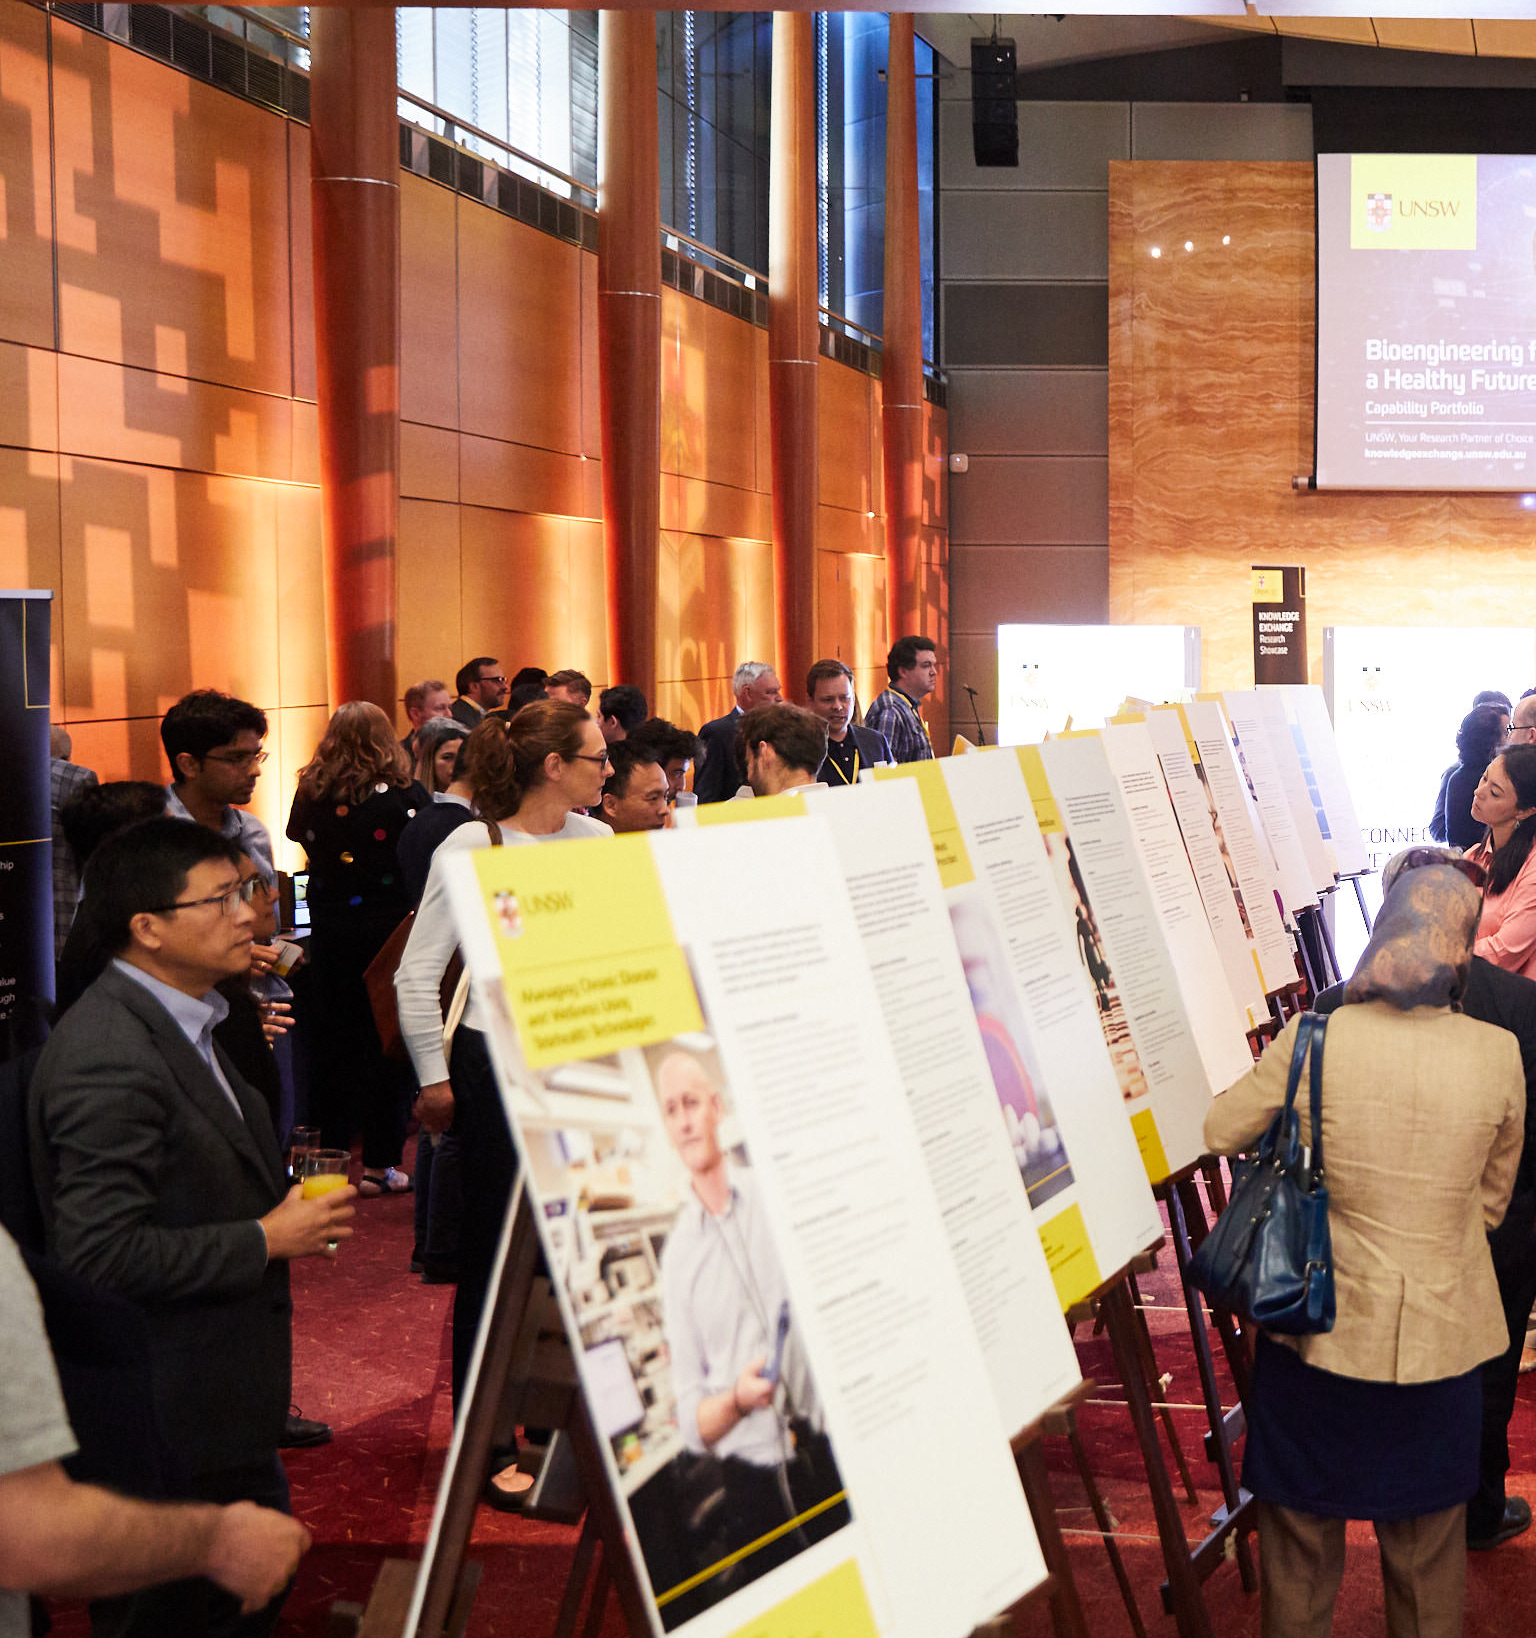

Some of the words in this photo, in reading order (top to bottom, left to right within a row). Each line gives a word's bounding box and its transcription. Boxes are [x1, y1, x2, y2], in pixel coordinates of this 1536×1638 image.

[1399, 200, 1461, 217] UNSW
[1365, 338, 1524, 367] Bioengineering
[1365, 373, 1379, 390] a
[1384, 368, 1466, 395] Healthy
[1365, 400, 1427, 417] Capability
[1430, 401, 1485, 415] Portfolio
[1365, 433, 1397, 444] UNSW,
[1399, 433, 1418, 443] Your
[1420, 432, 1459, 443] Research
[1461, 433, 1492, 443] Partner
[1495, 433, 1504, 443] of
[1505, 433, 1534, 444] Choice
[1364, 448, 1527, 461] knowledgeexchange.unsw.edu.au
[1258, 611, 1300, 621] KNOWLEDGE
[1258, 622, 1294, 633] EXCHANGE
[1259, 634, 1286, 644] Research
[1259, 645, 1289, 655] Showcase
[1360, 826, 1431, 844] CONNEC
[523, 890, 574, 916] UNSW
[521, 983, 580, 1004] Managing
